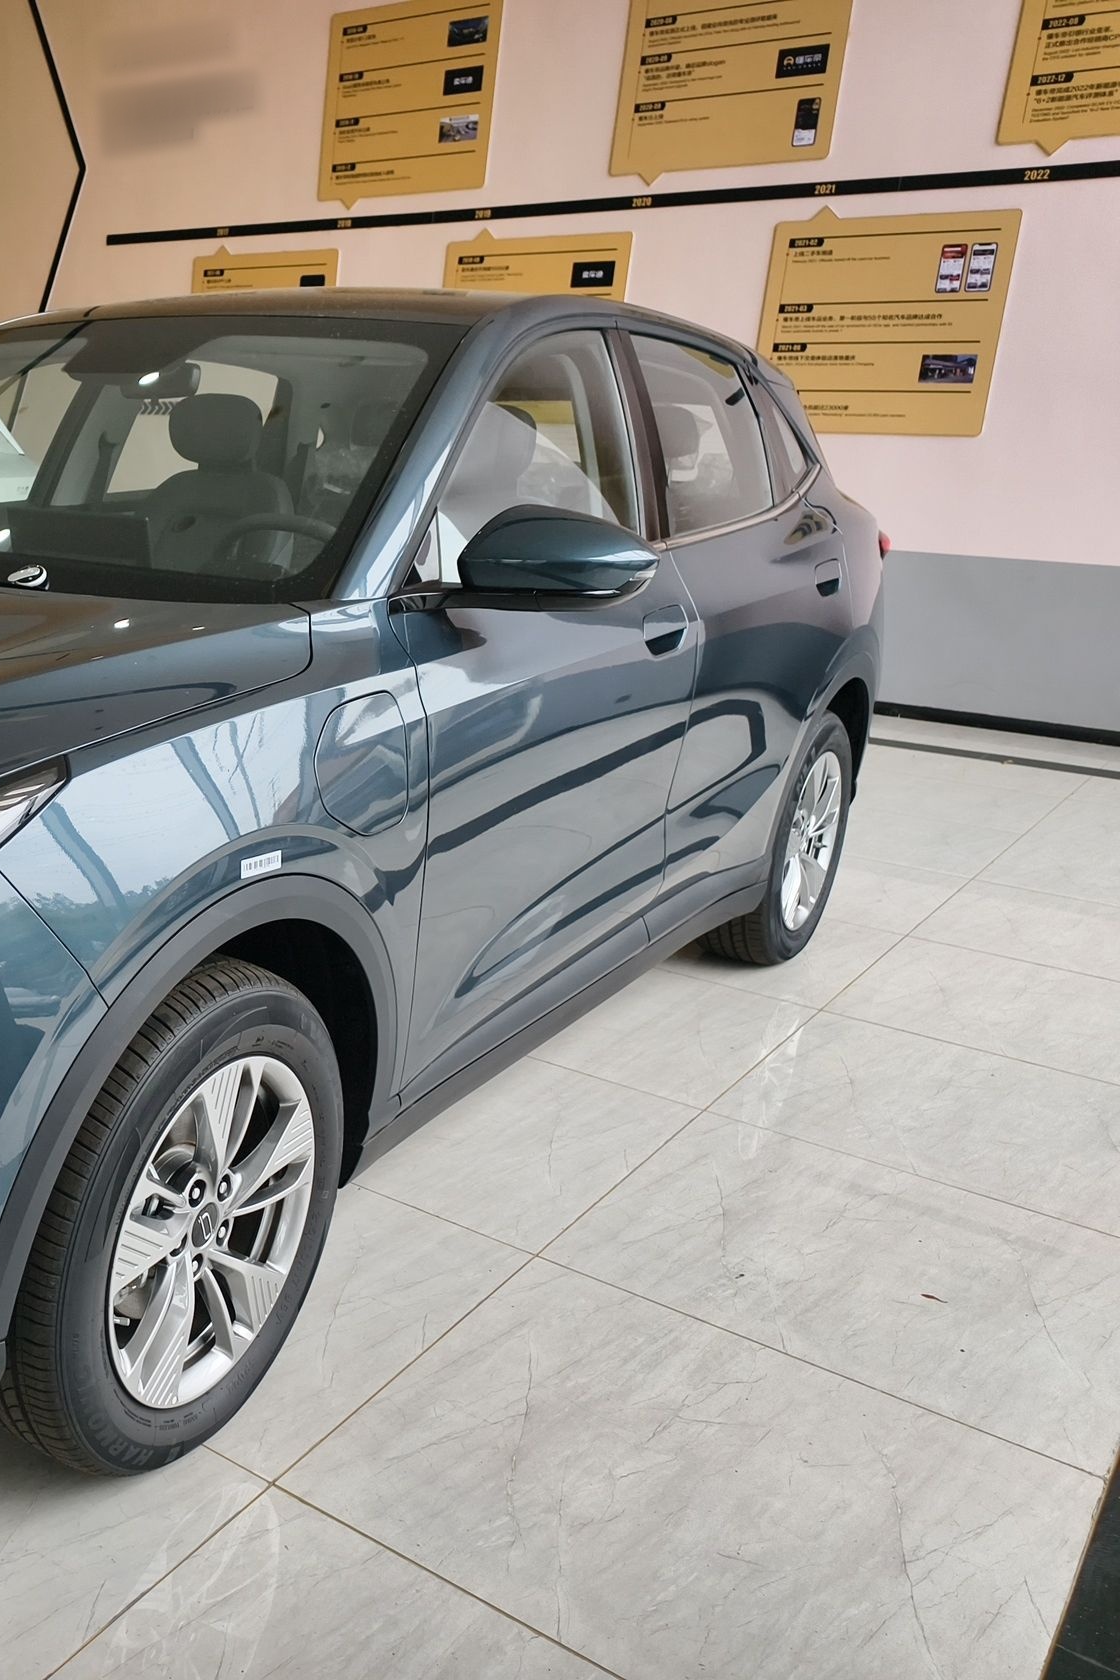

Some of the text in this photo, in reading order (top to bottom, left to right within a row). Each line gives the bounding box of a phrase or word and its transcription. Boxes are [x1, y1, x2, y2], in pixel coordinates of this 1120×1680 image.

[1023, 169, 1051, 181] 2022
[814, 183, 836, 195] 2021
[632, 196, 652, 207] 2020
